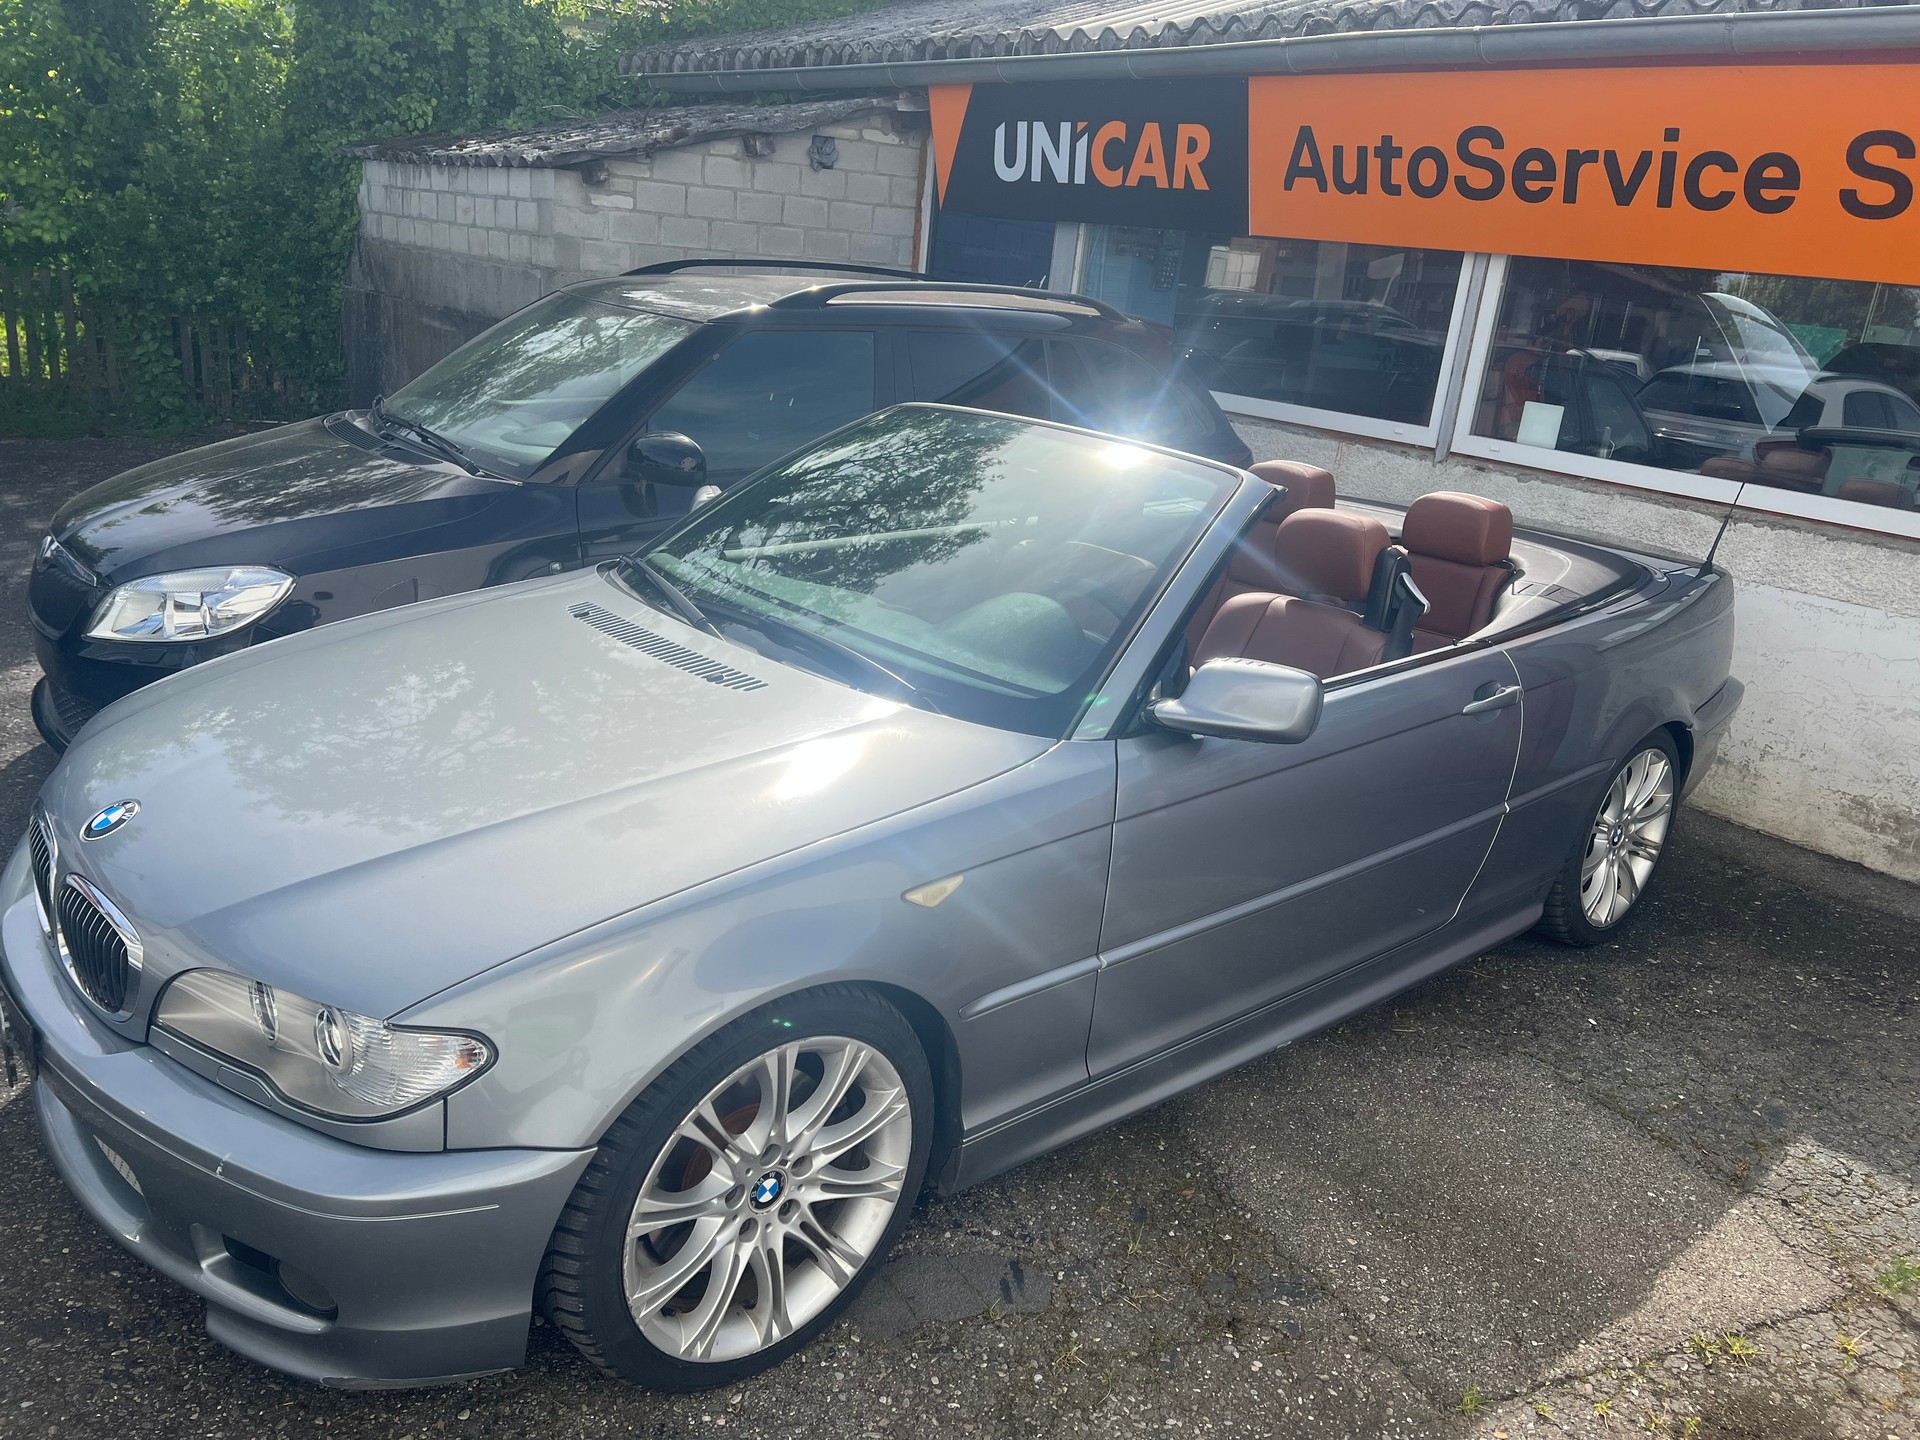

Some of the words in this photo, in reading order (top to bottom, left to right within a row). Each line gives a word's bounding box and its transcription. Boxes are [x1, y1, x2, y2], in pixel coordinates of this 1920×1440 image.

[1284, 124, 1801, 215] AutoService
[1839, 129, 1917, 220] S
[751, 1171, 776, 1198] BMW
